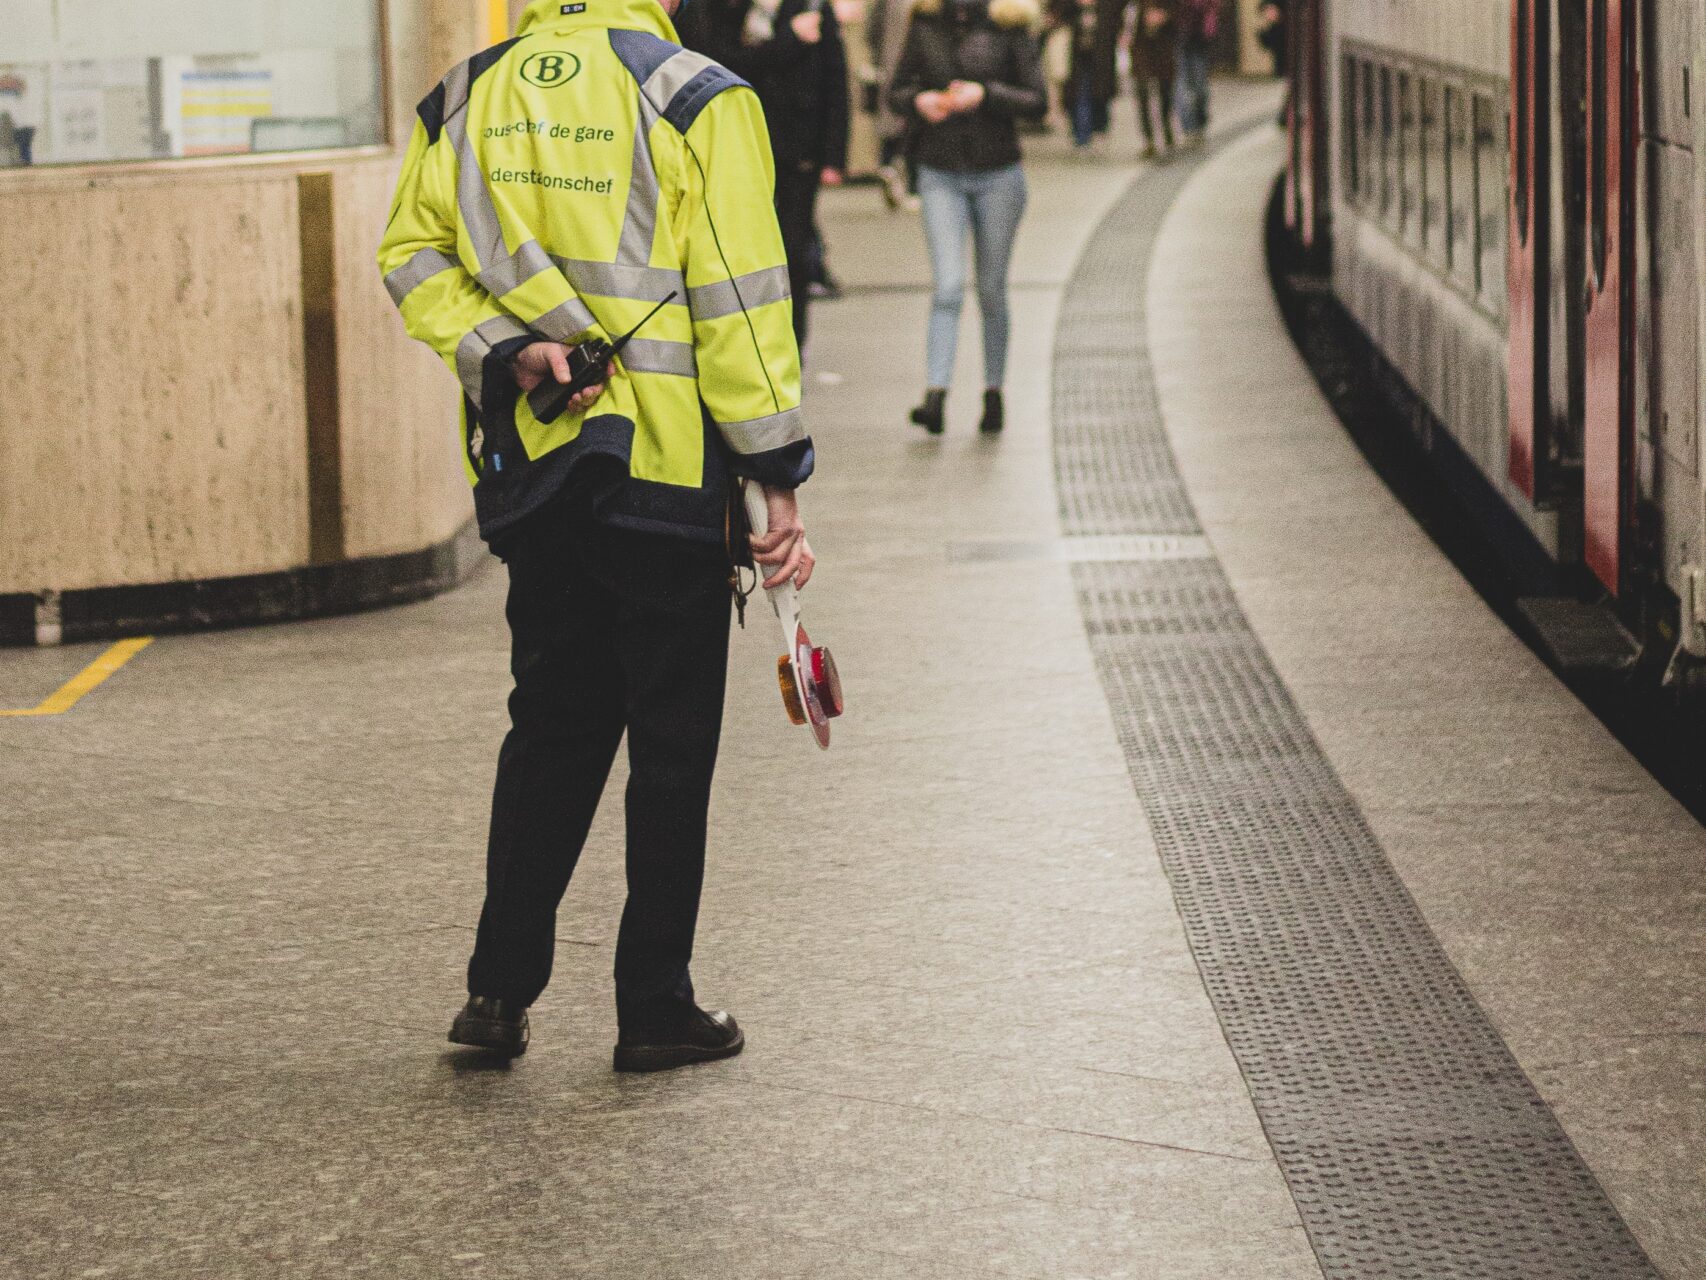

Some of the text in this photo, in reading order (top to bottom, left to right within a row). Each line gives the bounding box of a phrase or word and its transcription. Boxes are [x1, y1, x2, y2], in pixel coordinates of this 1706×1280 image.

[535, 55, 564, 82] B
[549, 123, 570, 138] de
[574, 126, 615, 143] gare
